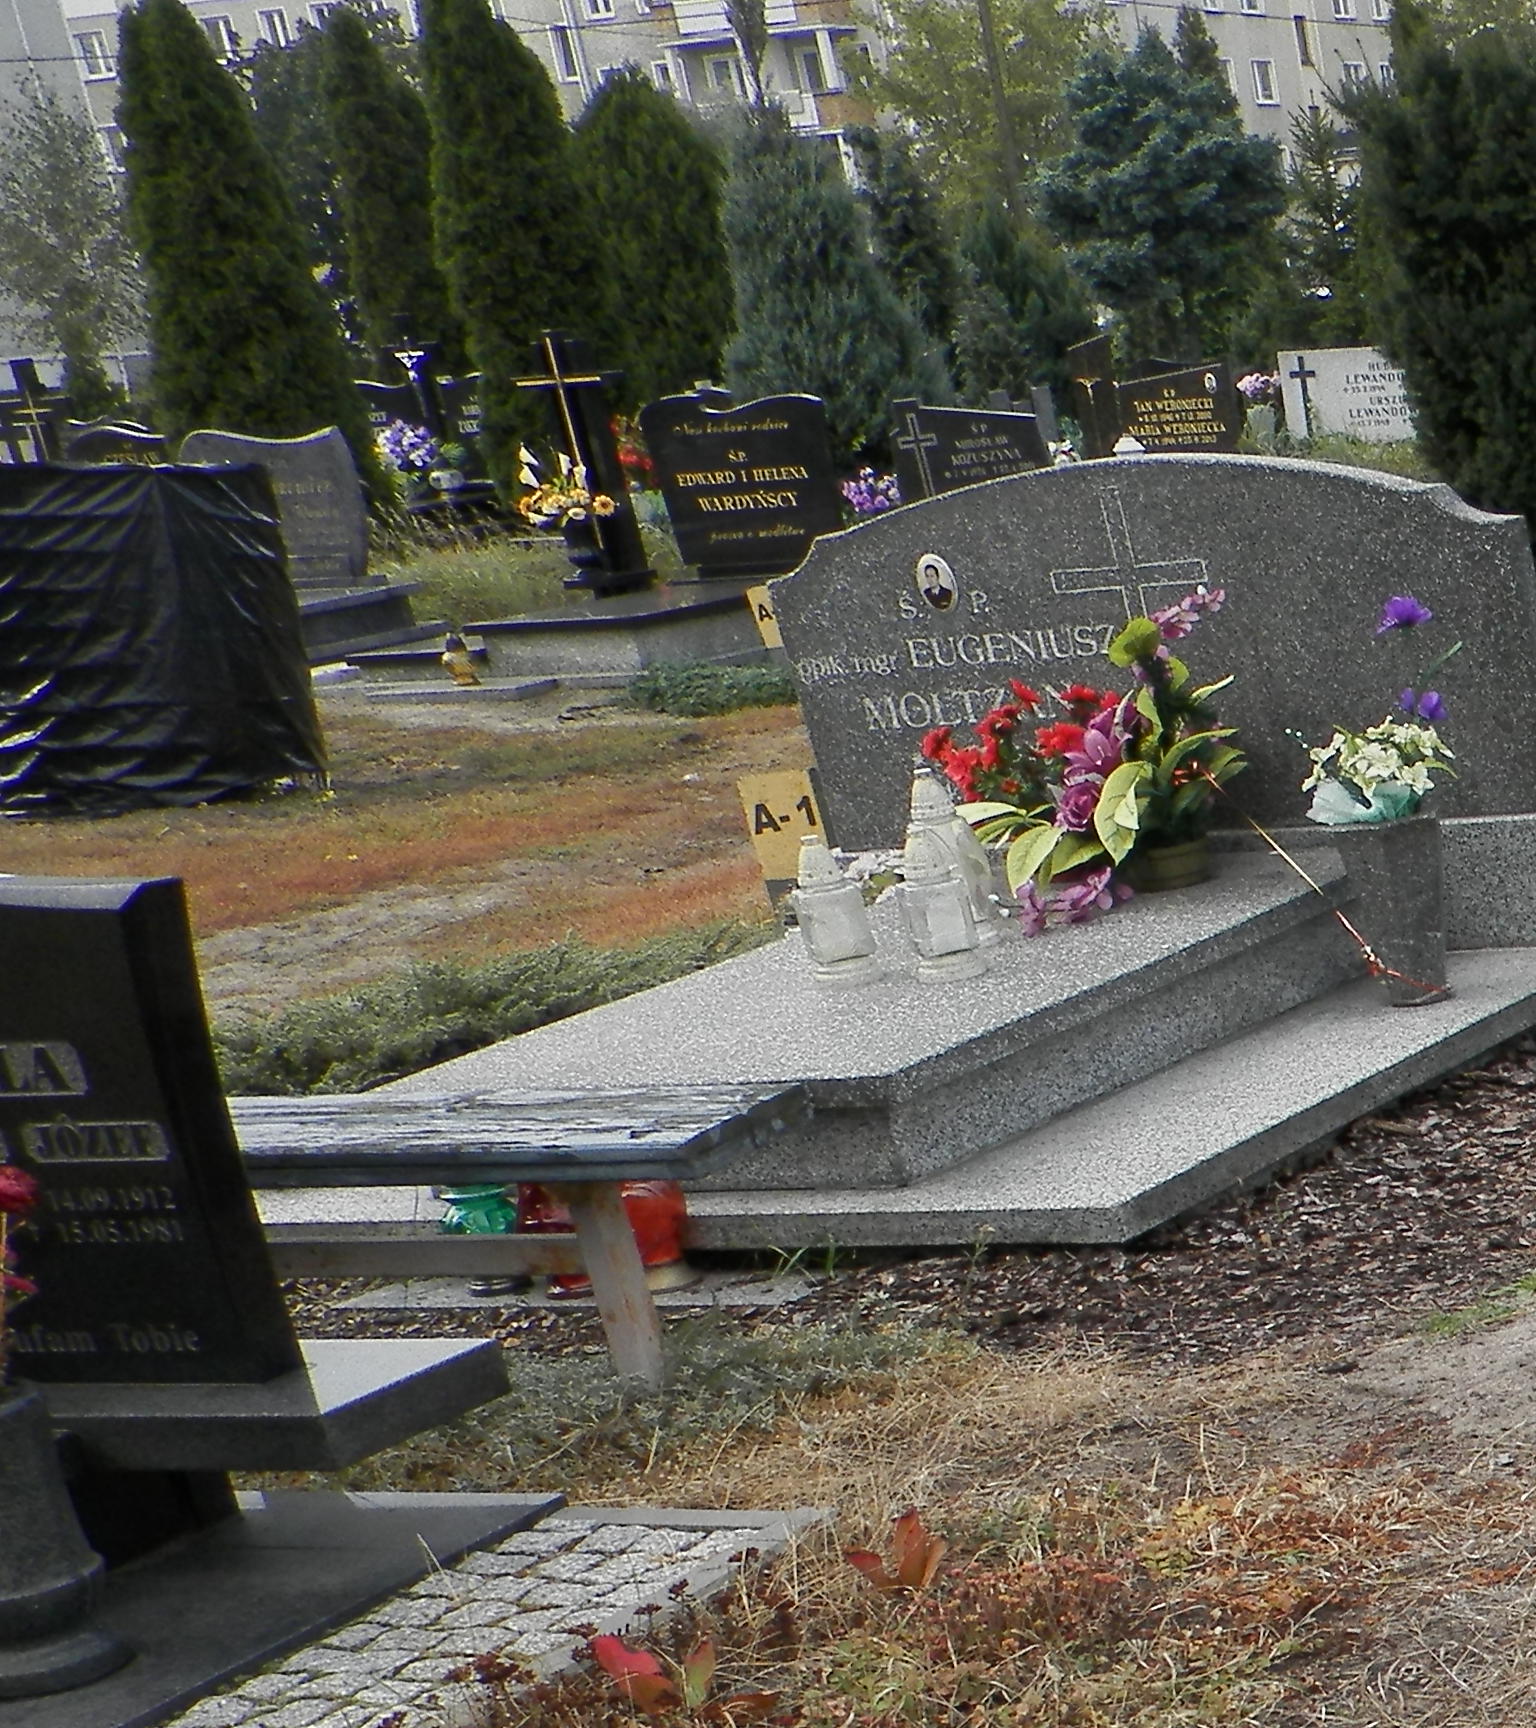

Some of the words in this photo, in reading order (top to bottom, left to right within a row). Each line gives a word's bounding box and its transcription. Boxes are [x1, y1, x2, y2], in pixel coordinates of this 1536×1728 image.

[676, 470, 736, 487] EDWARD
[740, 470, 748, 483] I
[752, 466, 809, 482] HELENA
[906, 624, 1114, 669] EUGENIUSZ
[108, 1321, 200, 1352] Tobie
